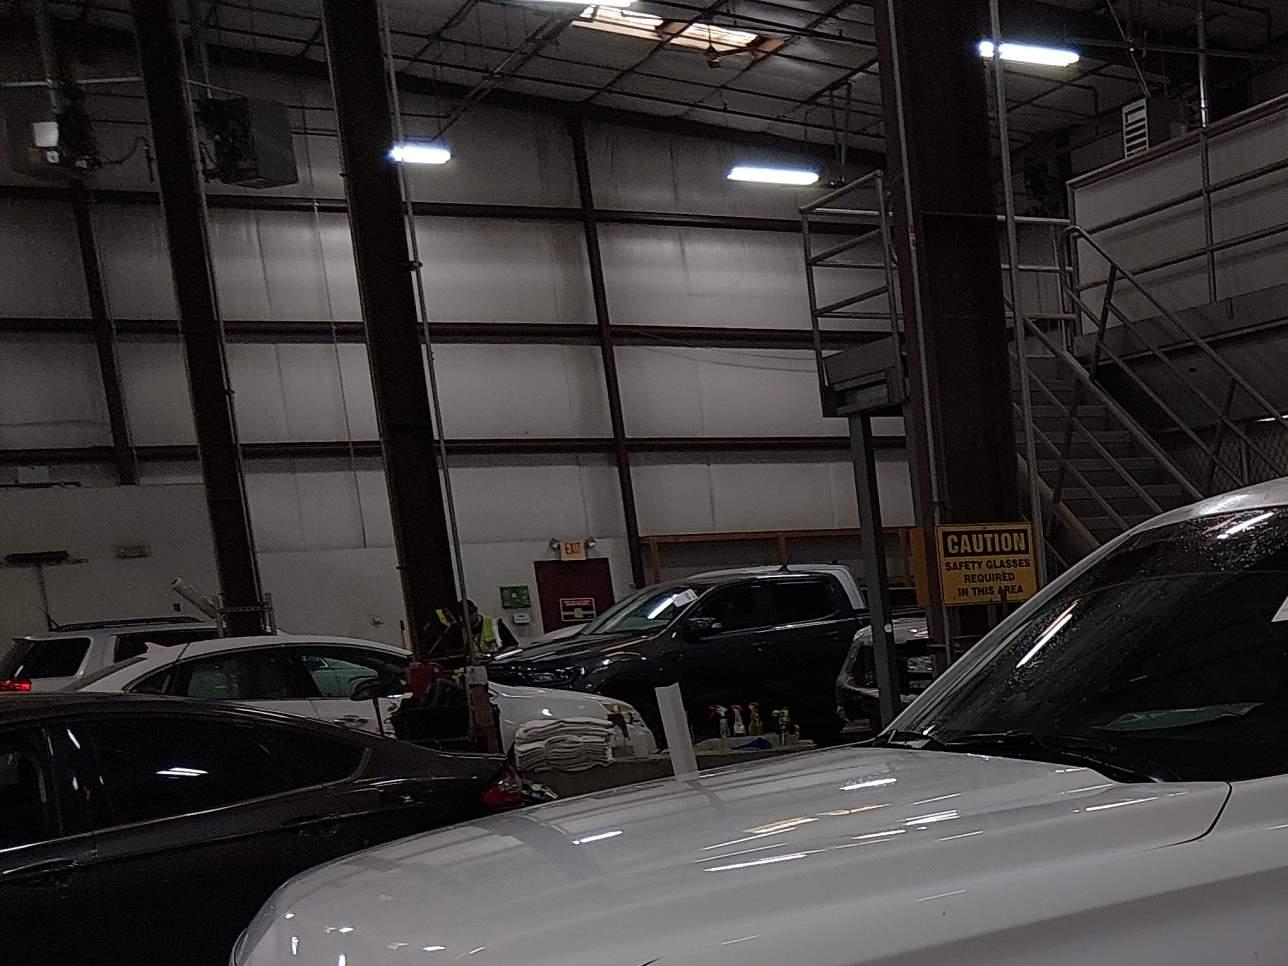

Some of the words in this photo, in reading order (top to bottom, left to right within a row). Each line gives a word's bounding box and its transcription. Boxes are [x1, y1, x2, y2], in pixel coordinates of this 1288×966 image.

[946, 532, 1026, 554] CAUTION
[945, 560, 983, 572] SAFETY
[986, 559, 1031, 570] GLASSES
[964, 572, 1015, 583] REQUIRED
[957, 587, 968, 597] IN
[971, 586, 994, 596] THIS
[998, 584, 1024, 596] AREA
